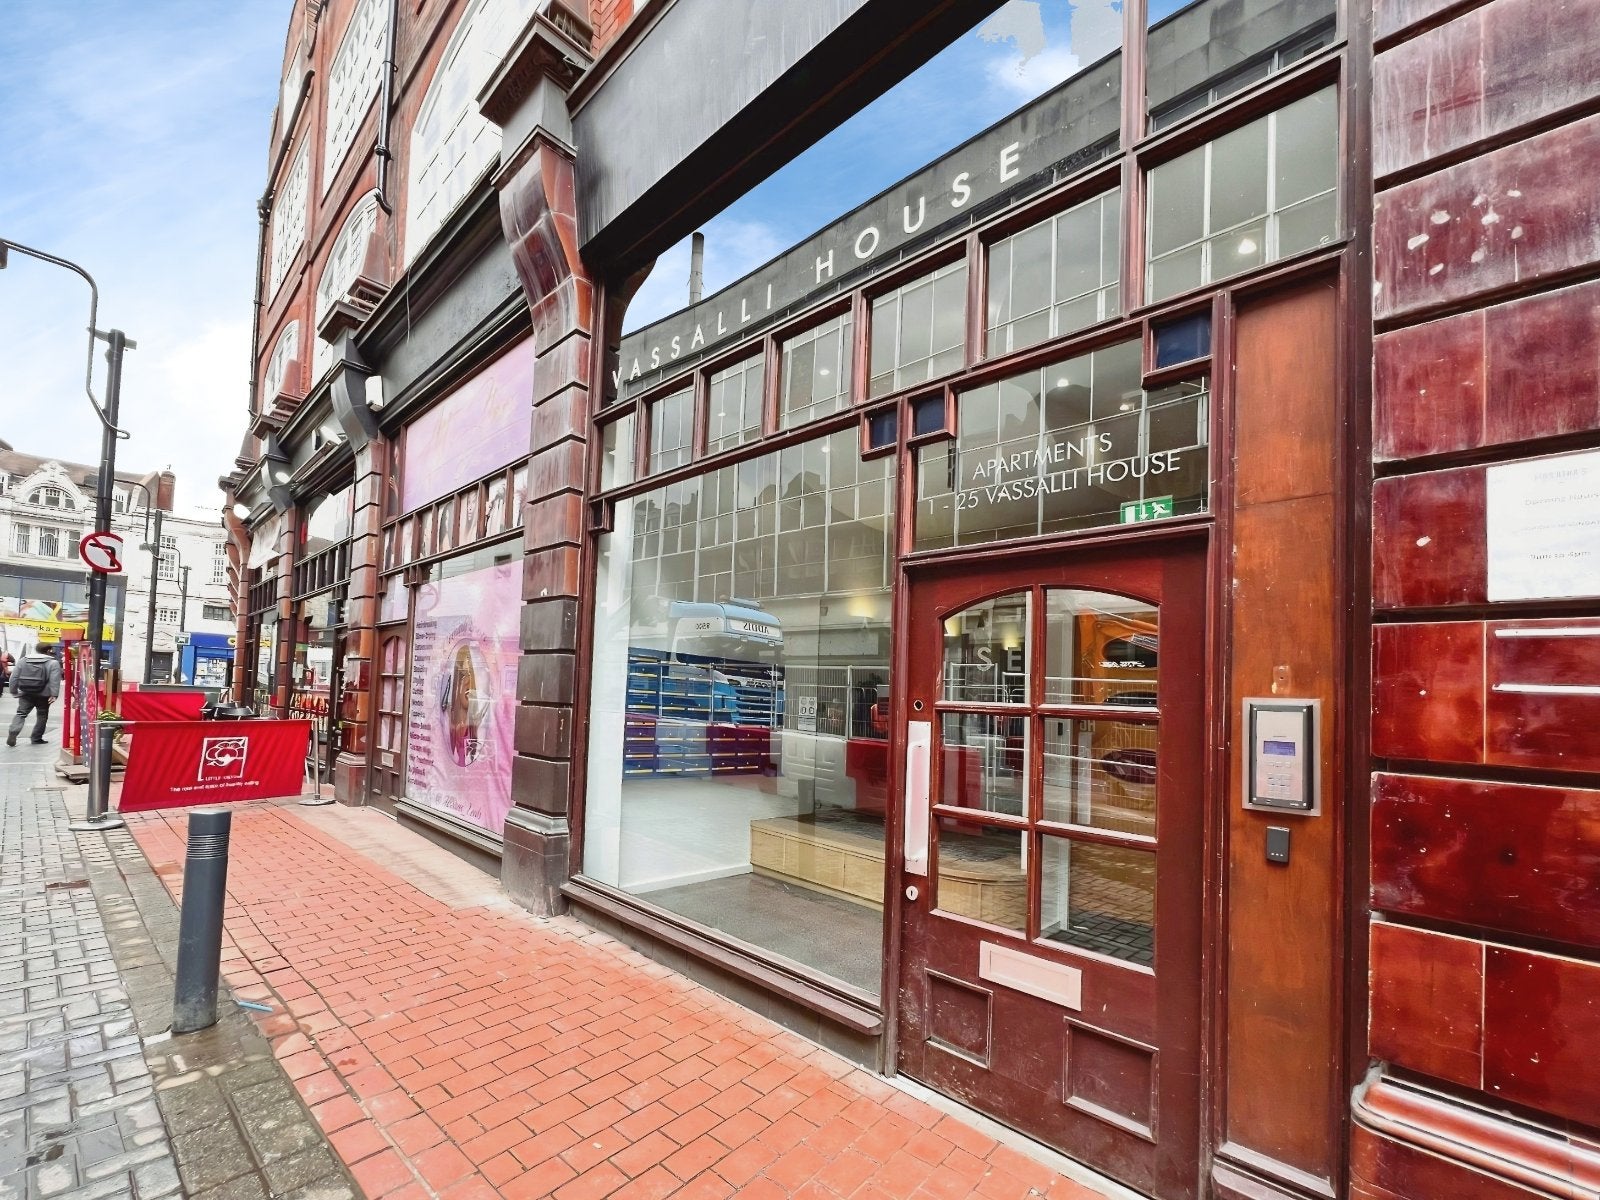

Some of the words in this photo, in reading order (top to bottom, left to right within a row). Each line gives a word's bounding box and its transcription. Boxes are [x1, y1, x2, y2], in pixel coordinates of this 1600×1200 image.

[612, 284, 772, 390] VASSALLI
[815, 141, 1021, 284] HOUSE
[928, 499, 934, 515] 1
[956, 492, 979, 511] 25
[985, 469, 1077, 505] VASSALLI
[1087, 451, 1181, 487] HOUSE
[972, 432, 1113, 480] APARTMENTS
